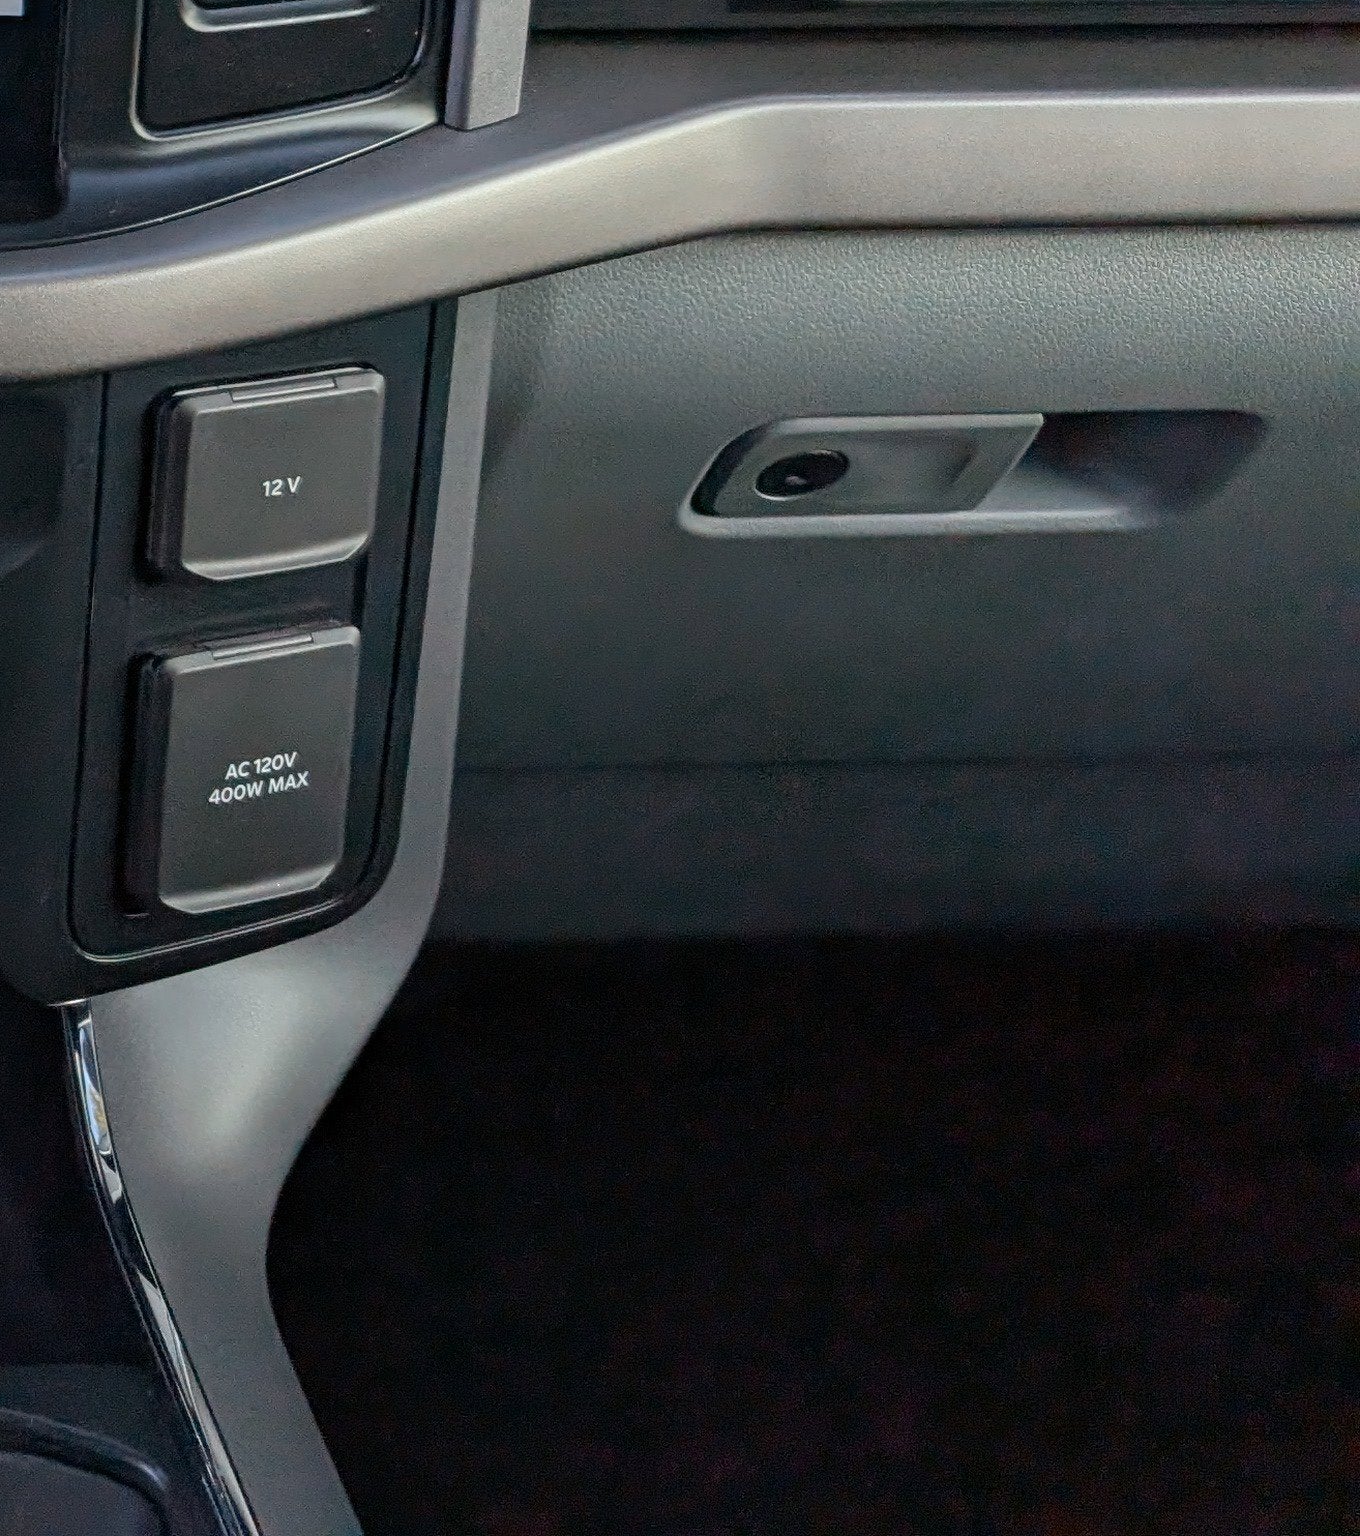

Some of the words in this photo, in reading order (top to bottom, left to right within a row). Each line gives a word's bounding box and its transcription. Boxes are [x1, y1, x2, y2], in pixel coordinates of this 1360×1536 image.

[263, 479, 285, 497] 12
[287, 476, 301, 494] V
[225, 760, 250, 780] AC
[254, 752, 297, 775] 120V
[209, 780, 264, 805] 400W
[267, 771, 309, 795] MAX
